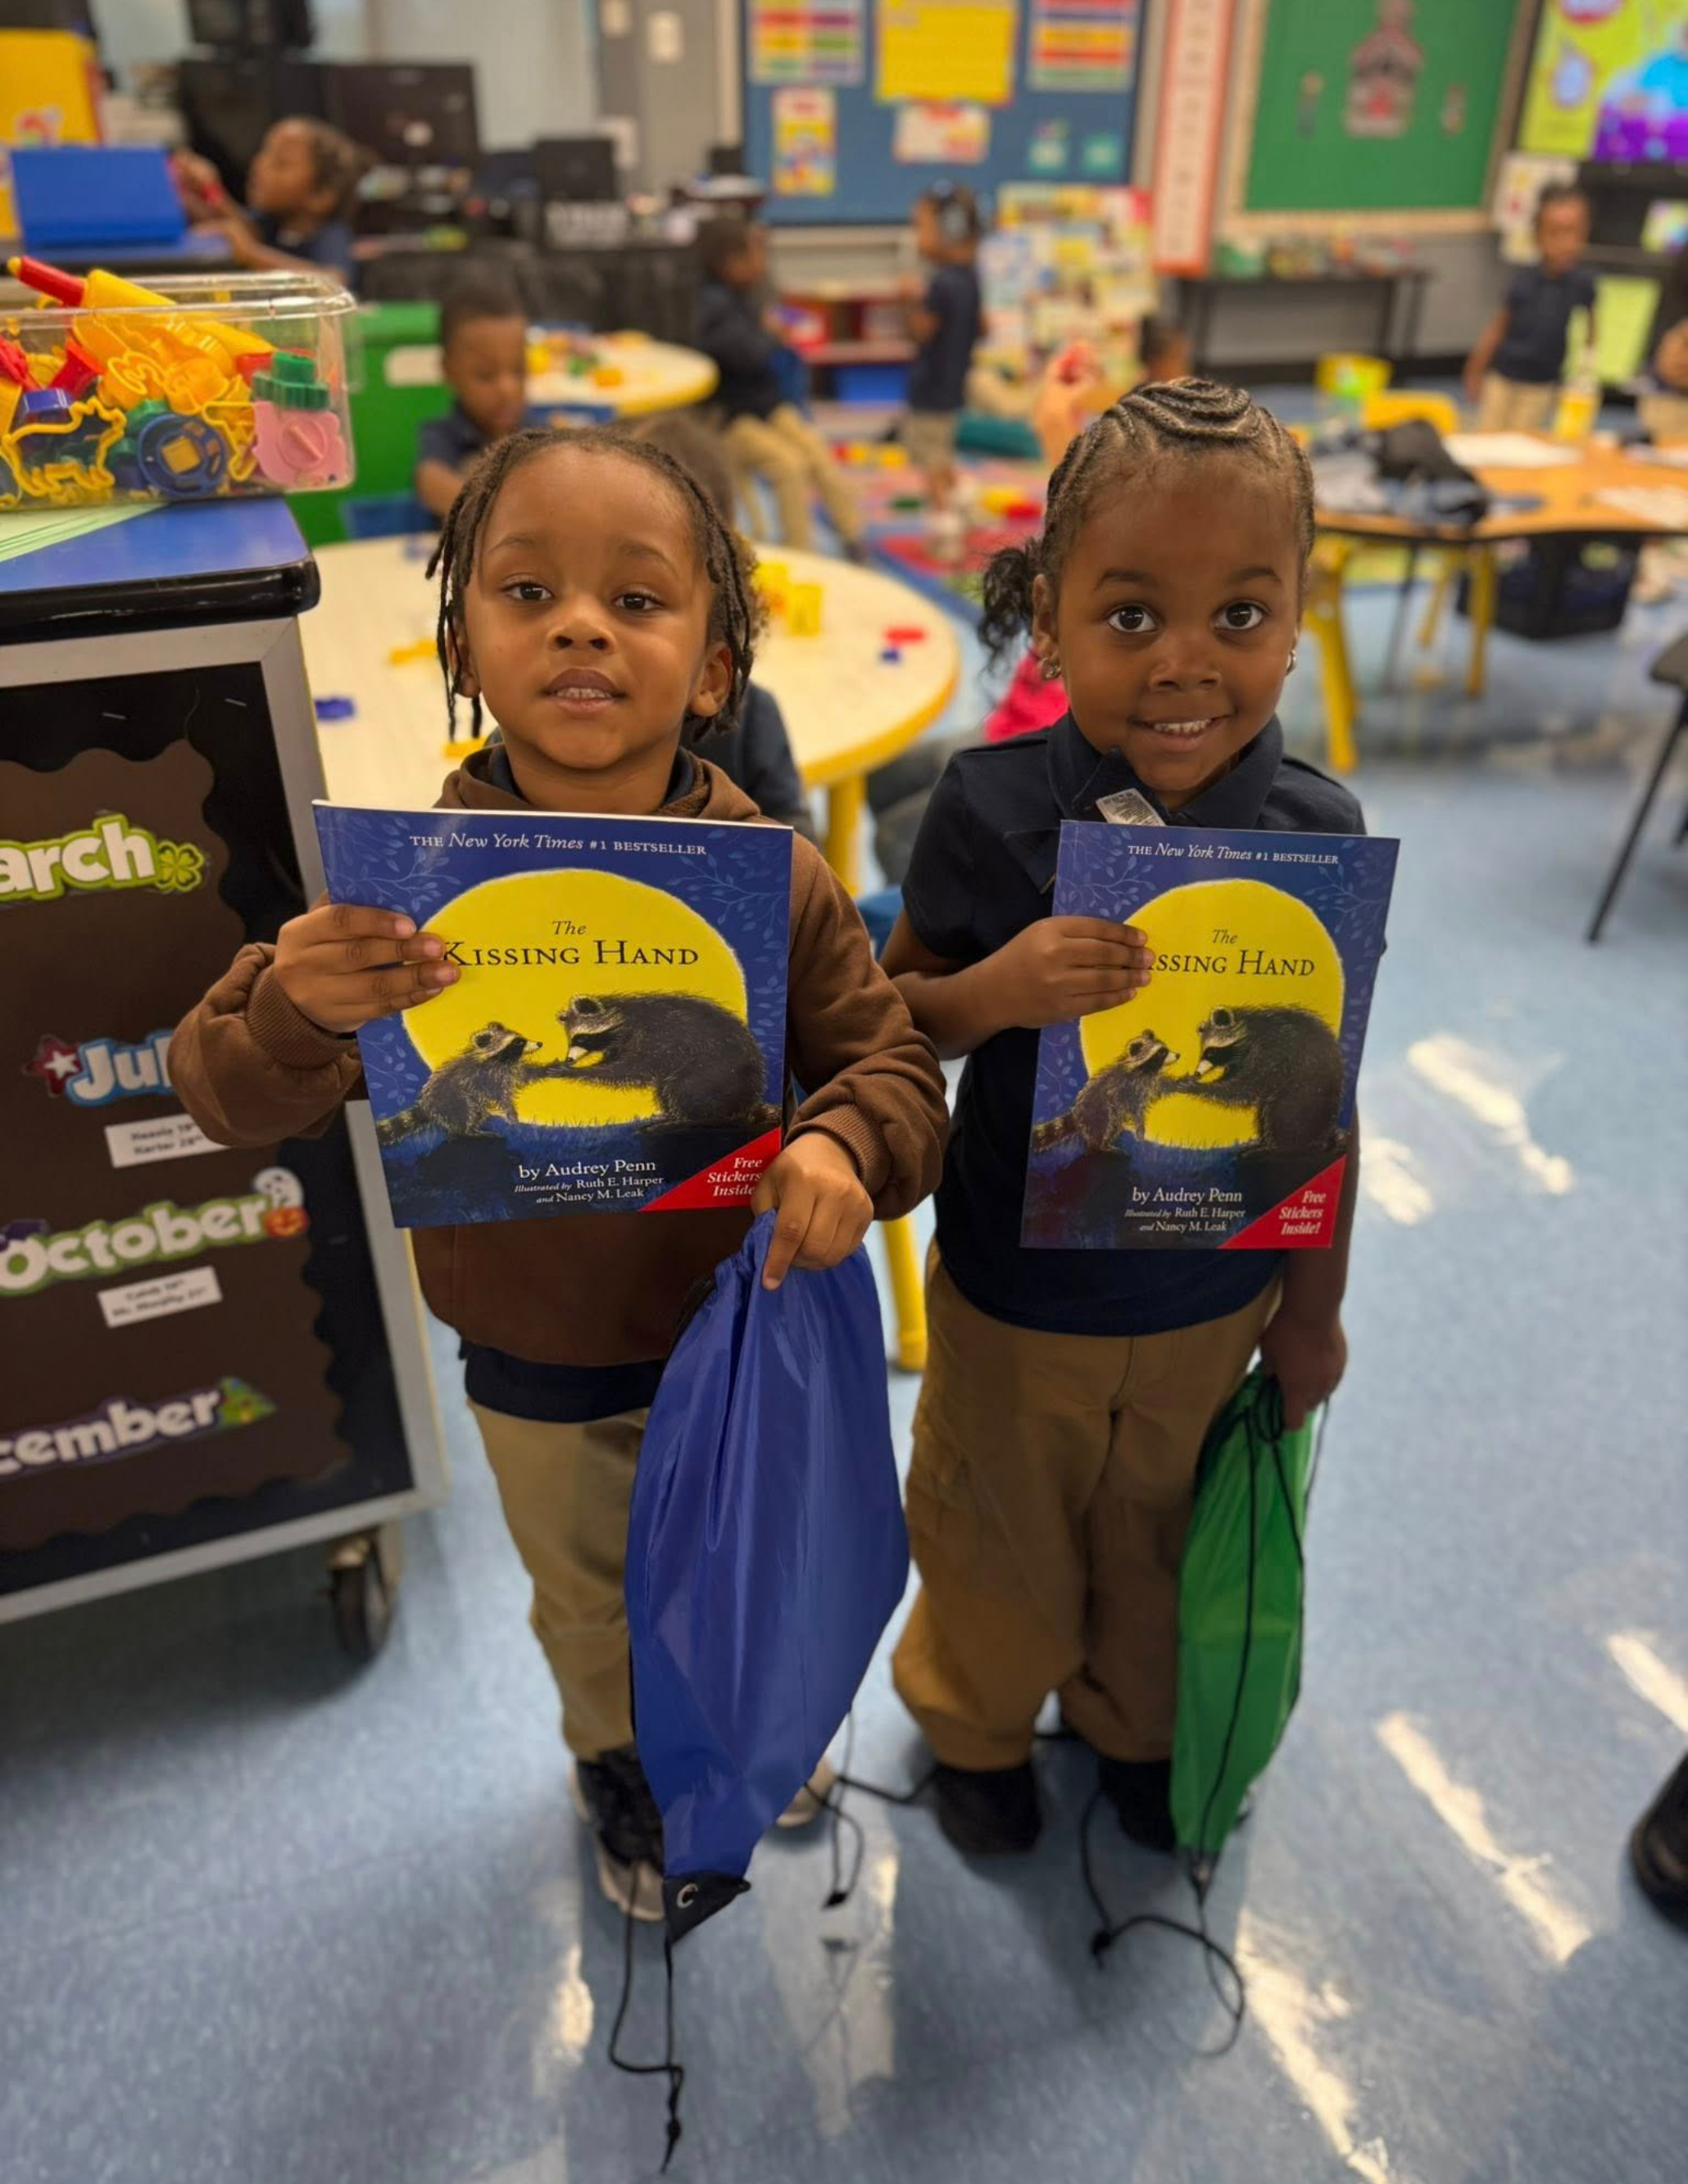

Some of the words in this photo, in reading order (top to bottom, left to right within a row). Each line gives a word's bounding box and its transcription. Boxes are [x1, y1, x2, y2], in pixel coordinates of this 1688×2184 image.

[410, 836, 443, 847] THE
[448, 833, 488, 848] New
[492, 833, 529, 848] York
[533, 834, 583, 850] Times
[589, 841, 607, 850] #1
[614, 841, 707, 855] BESTSELLER
[0, 822, 156, 893] arch
[1128, 845, 1152, 855] THE
[1155, 842, 1184, 857] New
[1187, 845, 1214, 859] York
[1218, 845, 1252, 860] Times
[1255, 853, 1268, 861] #1
[1273, 853, 1338, 864] BESTSELLER
[552, 921, 587, 935] The
[1213, 929, 1238, 944] The
[443, 941, 581, 967] KISSING
[593, 940, 700, 966] HAND
[1148, 954, 1227, 973] SSING
[1237, 949, 1315, 976] HAND
[73, 1036, 173, 1100] Jul
[519, 1164, 540, 1180] by
[545, 1162, 610, 1176] Audrey
[615, 1159, 656, 1172] Penn
[733, 1158, 763, 1169] Free
[515, 1183, 560, 1193] Illustrated
[560, 1183, 572, 1191] by
[576, 1178, 605, 1189] Ruth
[607, 1178, 619, 1186] E.
[622, 1176, 665, 1187] Harper
[707, 1171, 763, 1183] Stickers
[556, 1192, 594, 1202] Nancy
[597, 1189, 614, 1199] M.
[616, 1188, 644, 1198] Leak
[1132, 1186, 1150, 1205] by
[1152, 1187, 1205, 1205] Audrey
[1209, 1188, 1243, 1202] Penn
[1302, 1190, 1327, 1204] Free
[1125, 1209, 1161, 1218] Illustrated
[1162, 1209, 1172, 1219] by
[1174, 1207, 1198, 1218] Ruth
[1200, 1207, 1209, 1218] E.
[1212, 1208, 1246, 1220] Harper
[1278, 1206, 1323, 1220] Stickers
[1139, 1223, 1155, 1231] and
[1155, 1221, 1187, 1233] Nancy
[1188, 1221, 1203, 1231] M.
[1205, 1221, 1227, 1231] Leak
[1280, 1221, 1322, 1236] Inside!
[0, 1200, 267, 1290] October
